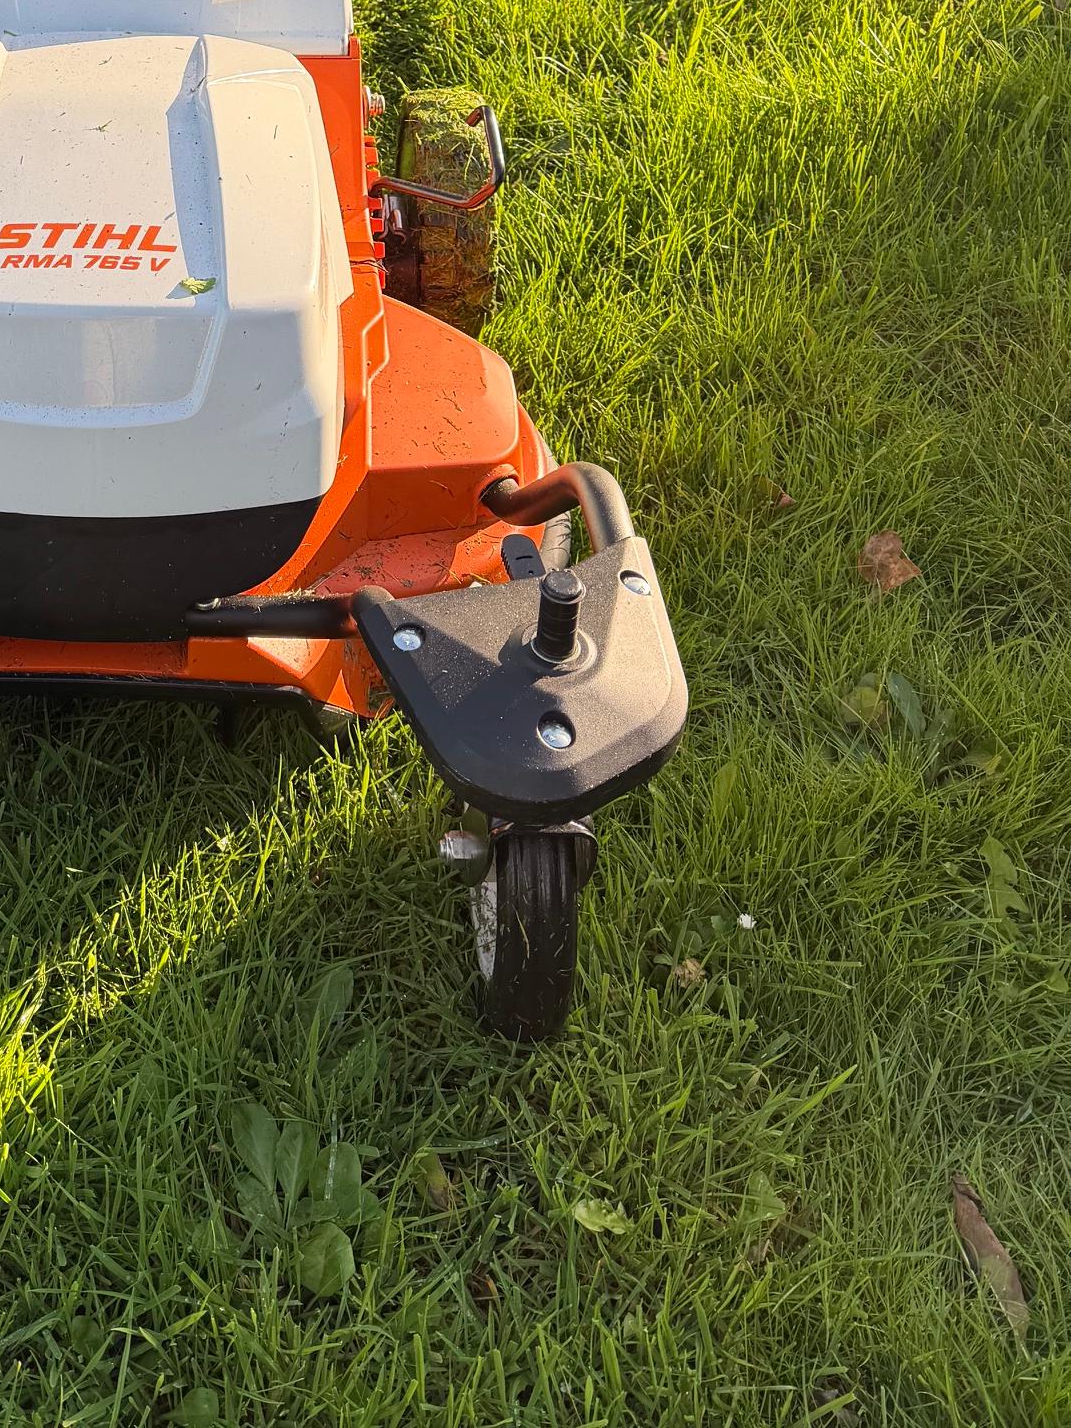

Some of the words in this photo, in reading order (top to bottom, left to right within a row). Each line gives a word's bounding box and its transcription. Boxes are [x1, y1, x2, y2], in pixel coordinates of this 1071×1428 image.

[0, 254, 73, 269] RMA
[83, 254, 142, 271] 765
[150, 257, 171, 272] V
